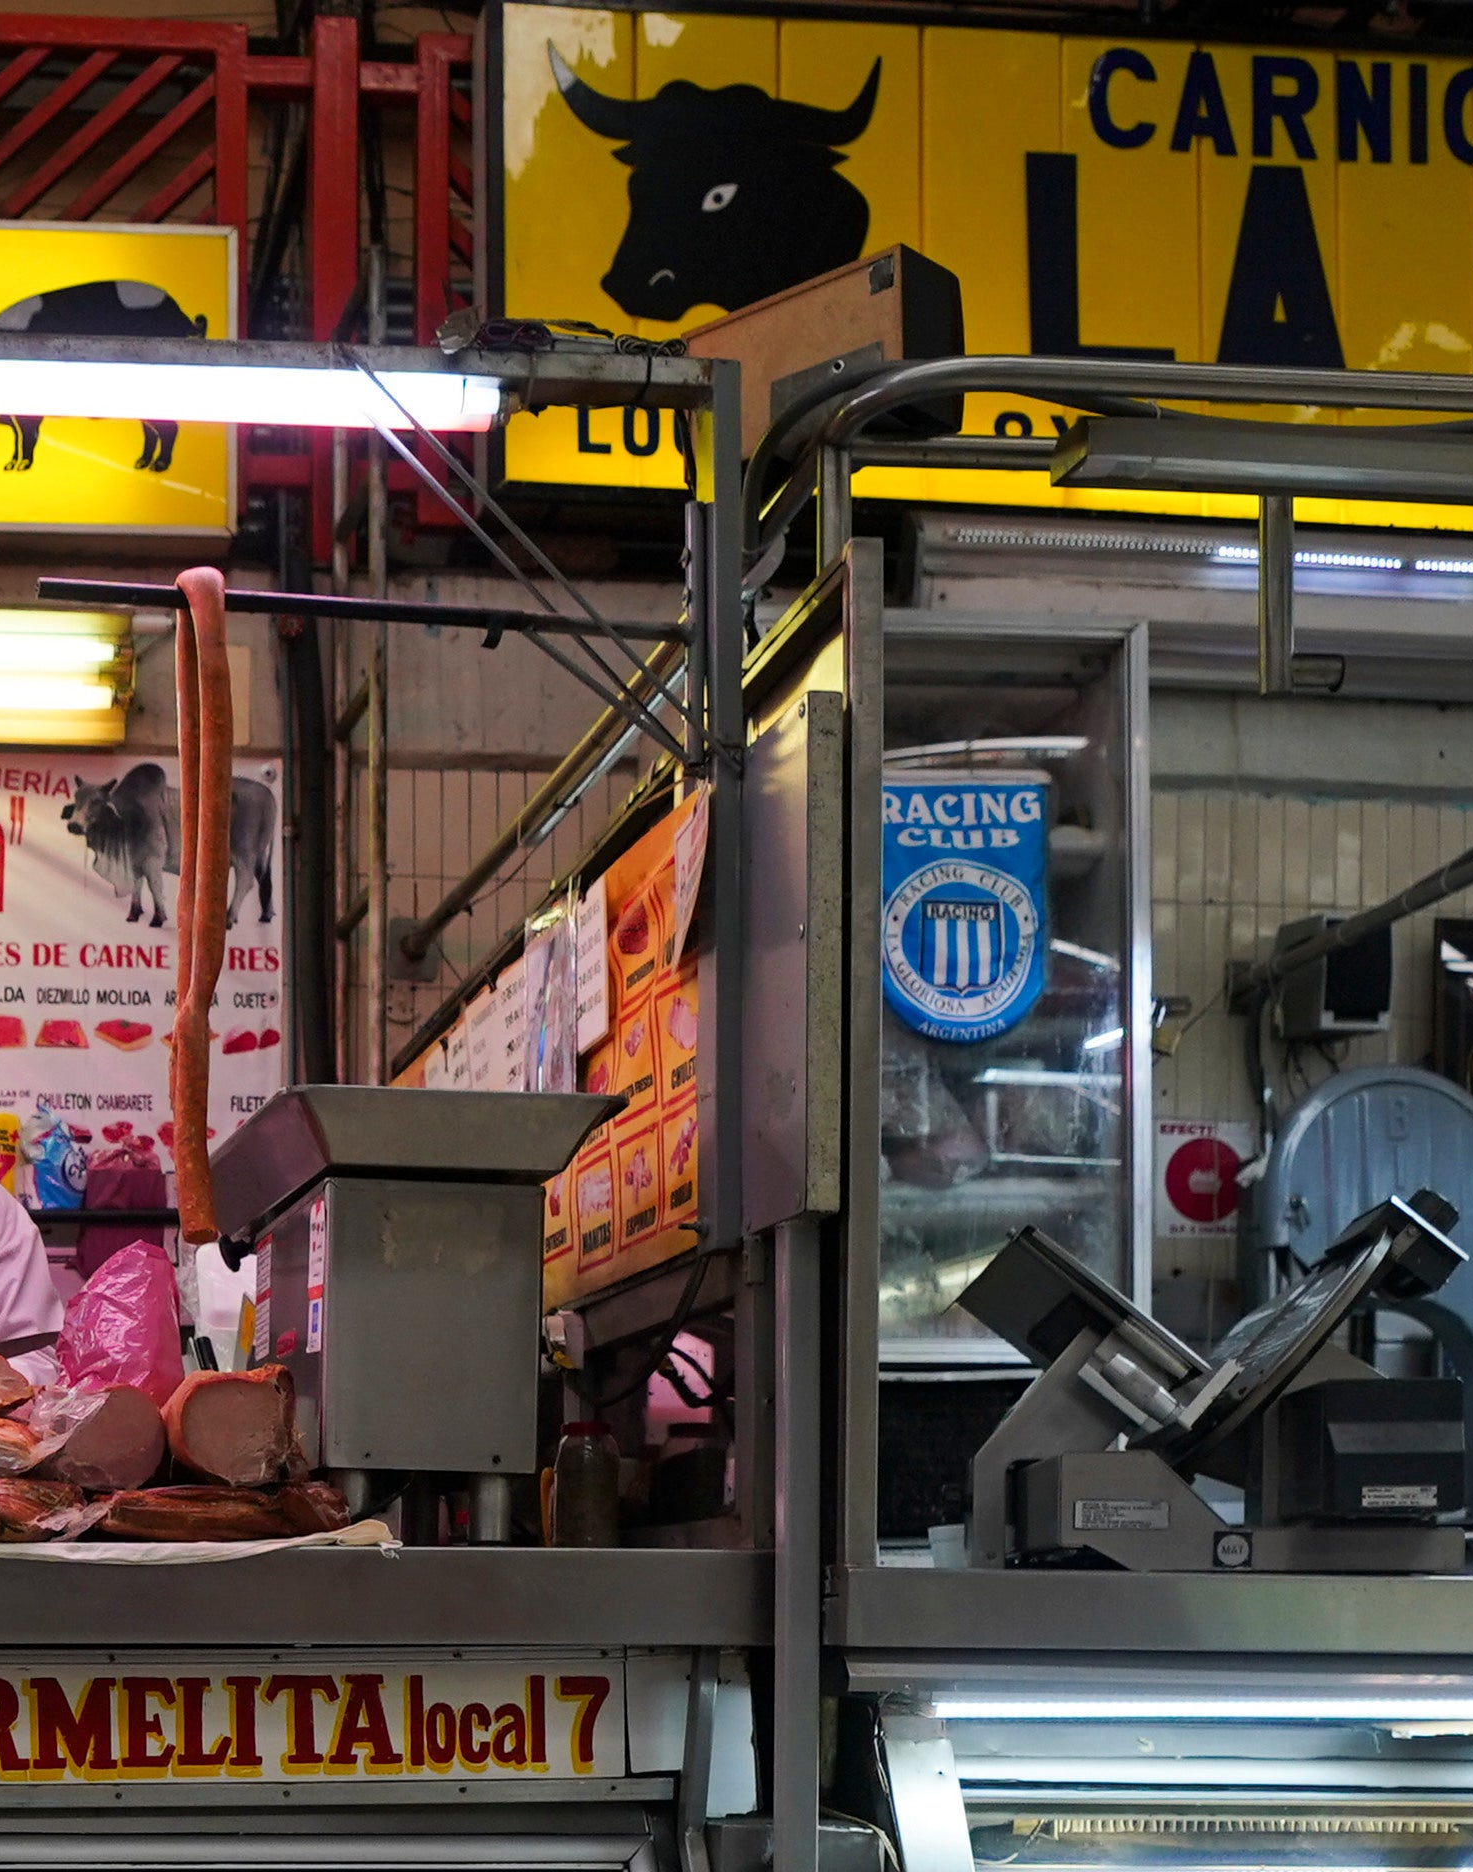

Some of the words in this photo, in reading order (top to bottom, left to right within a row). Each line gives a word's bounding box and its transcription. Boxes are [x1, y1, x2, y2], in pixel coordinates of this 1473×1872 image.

[1025, 152, 1347, 370] LA
[882, 791, 1041, 826] RACING
[896, 827, 1020, 849] CLUB
[898, 865, 965, 908] RACING
[979, 873, 1024, 909] CLUB
[929, 904, 992, 919] RACING
[32, 943, 69, 968] DE
[79, 942, 171, 970] CARNE
[227, 945, 279, 971] RES
[36, 988, 90, 1005] DIEZMILLO
[96, 989, 152, 1006] MOLIDA
[896, 962, 966, 1014] GLORIOSA
[233, 992, 267, 1009] CUETE
[918, 1018, 1007, 1040] ARGENTINA
[37, 1093, 92, 1111] CHULETON
[96, 1094, 153, 1111] CHAMBARETE
[404, 1674, 547, 1776] local
[553, 1676, 610, 1776] 7
